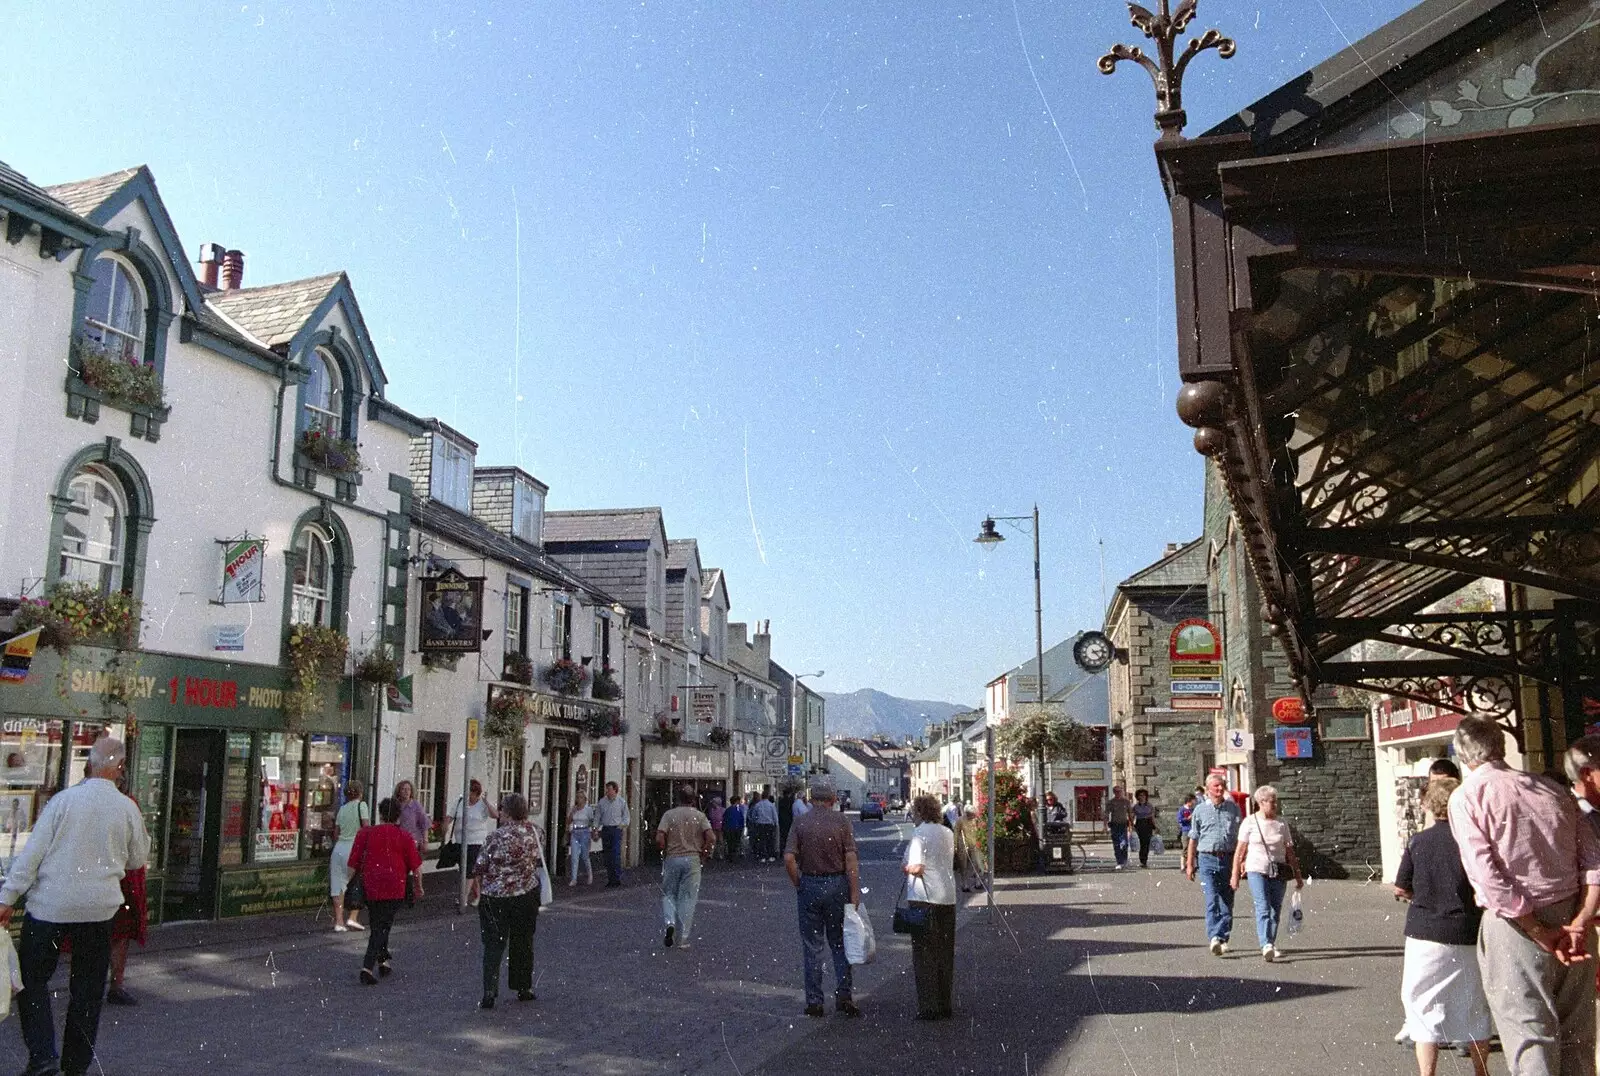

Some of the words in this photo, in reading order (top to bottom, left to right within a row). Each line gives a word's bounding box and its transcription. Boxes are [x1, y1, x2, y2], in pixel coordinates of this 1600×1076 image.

[233, 545, 259, 570] HOUR
[435, 582, 469, 591] JENNINGS
[71, 669, 119, 694] SAM
[168, 675, 179, 705] 1
[184, 675, 238, 709] HOUR
[249, 687, 282, 708] PHOTO
[542, 700, 562, 717] BANK
[1282, 701, 1301, 710] Post
[275, 834, 295, 842] HOUR
[275, 842, 295, 851] PHOTO
